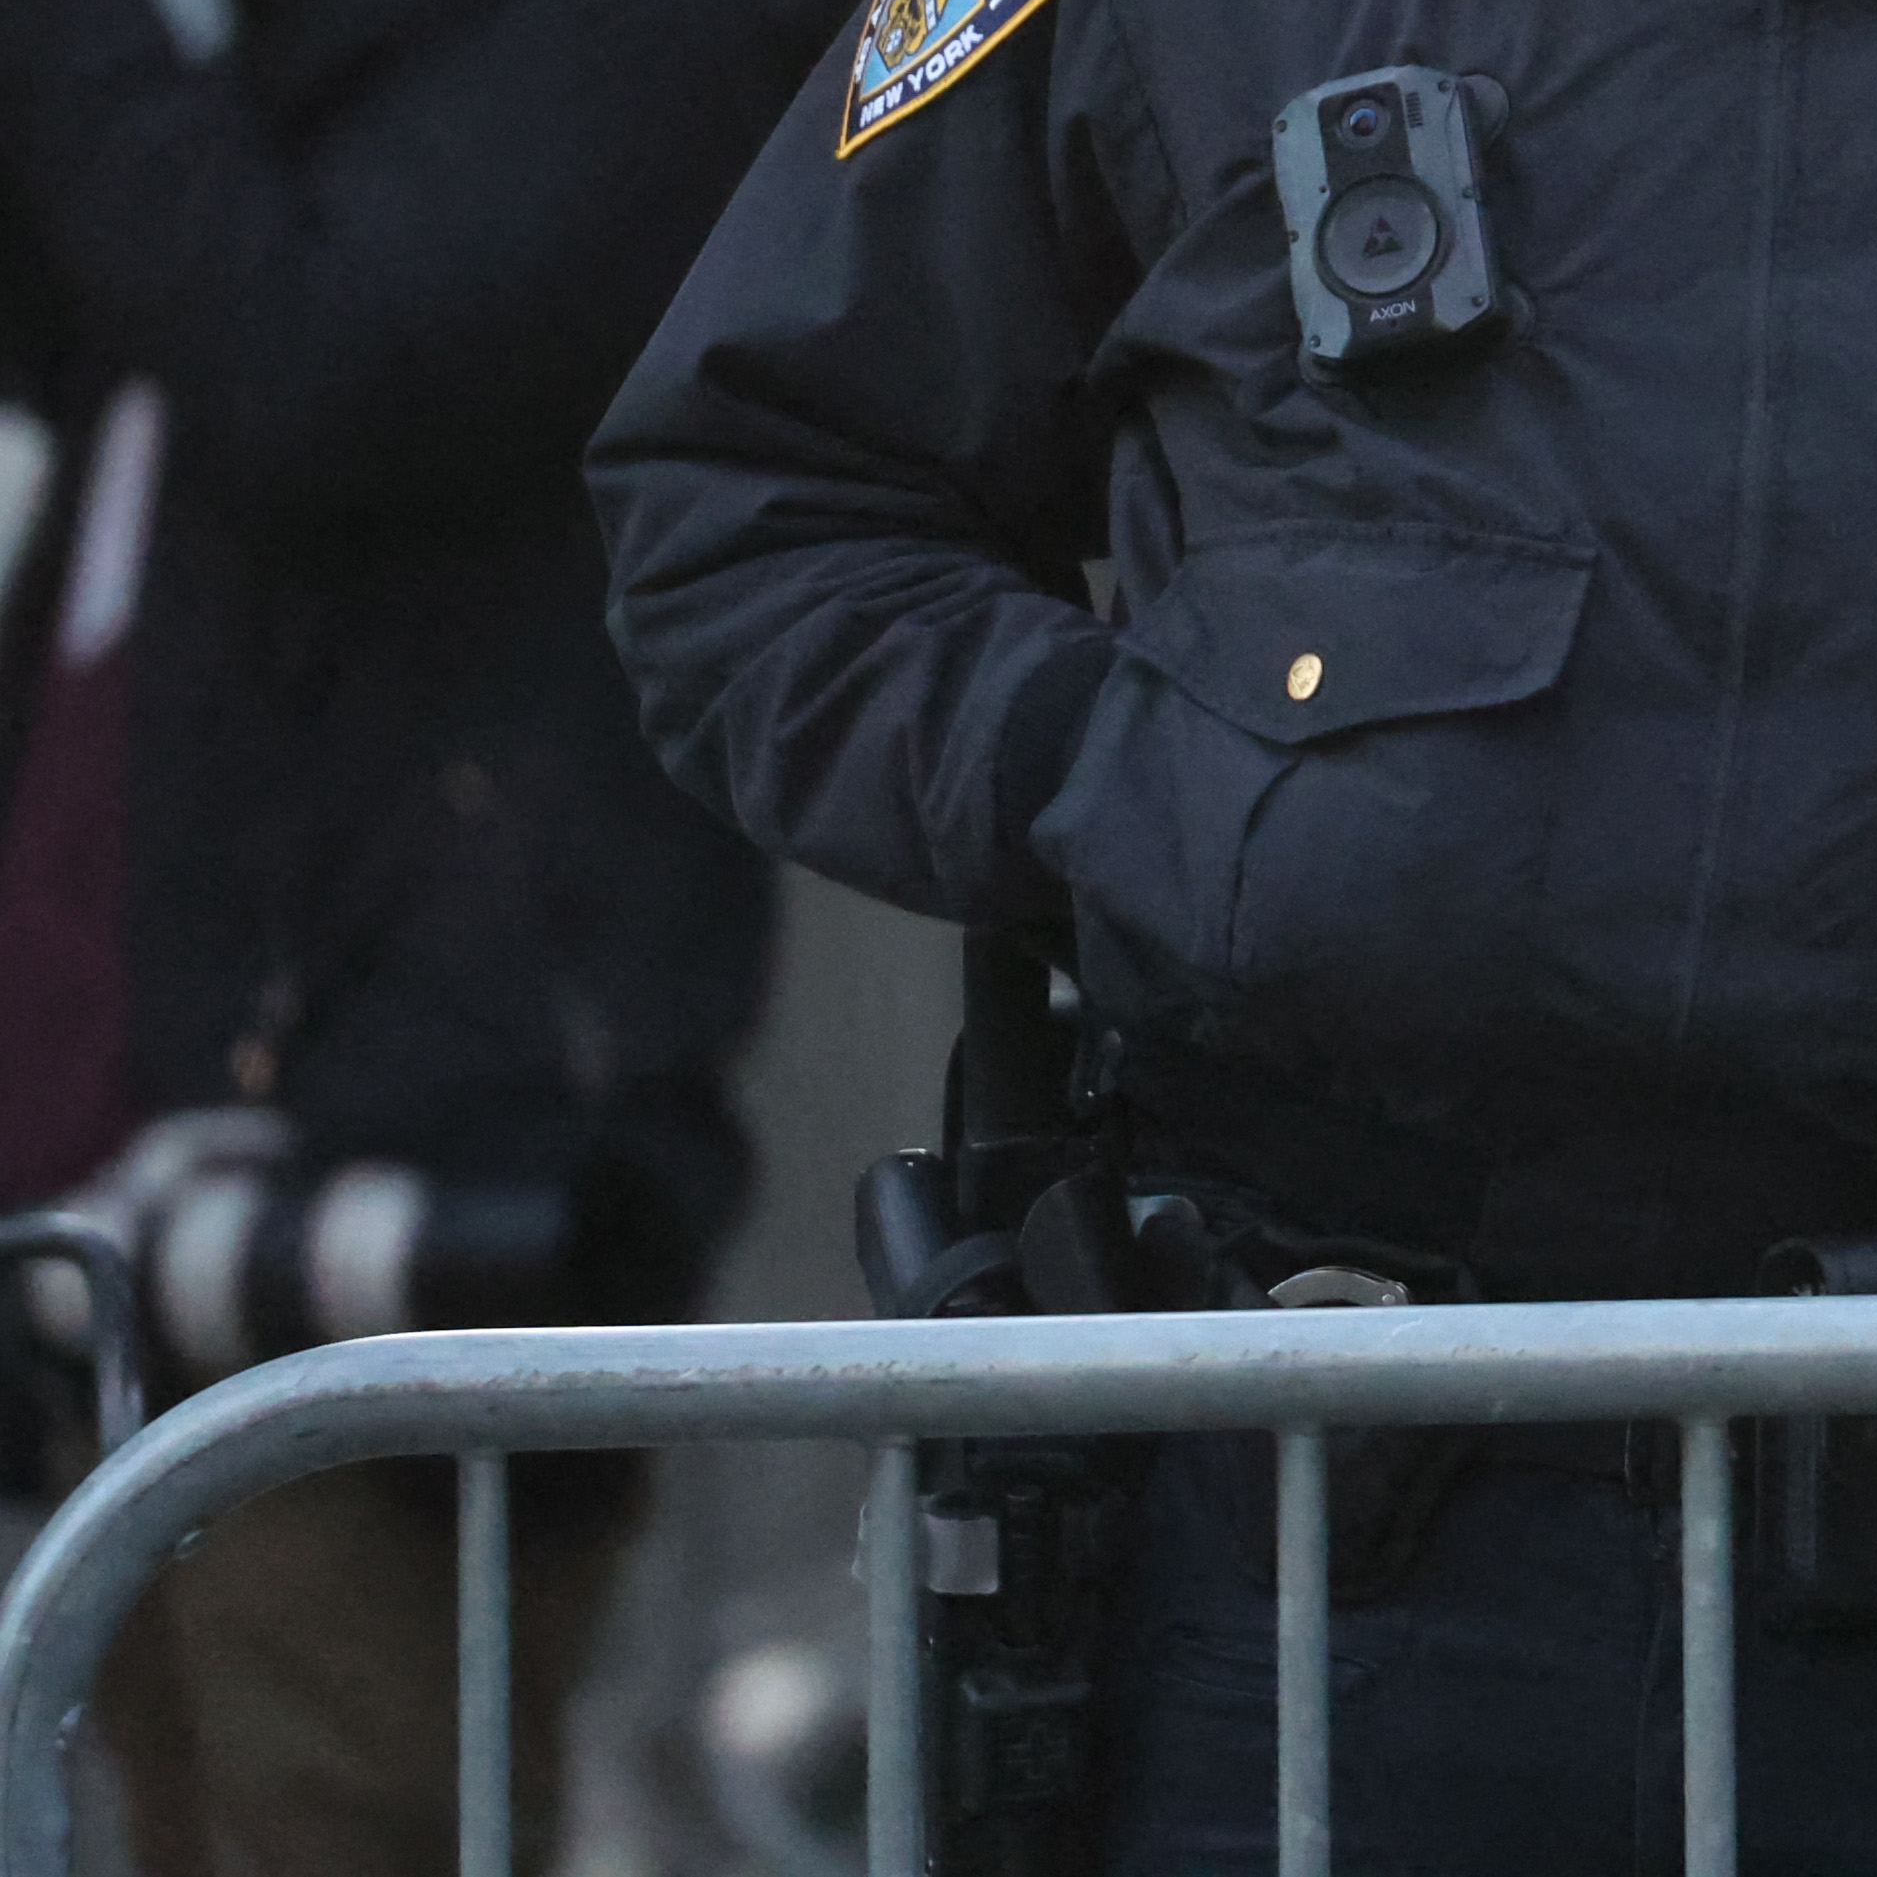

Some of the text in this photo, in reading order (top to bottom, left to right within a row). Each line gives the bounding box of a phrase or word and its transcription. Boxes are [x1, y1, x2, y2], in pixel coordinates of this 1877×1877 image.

[859, 81, 903, 129] NEW
[906, 24, 984, 92] YORK
[1369, 299, 1417, 323] AXON
